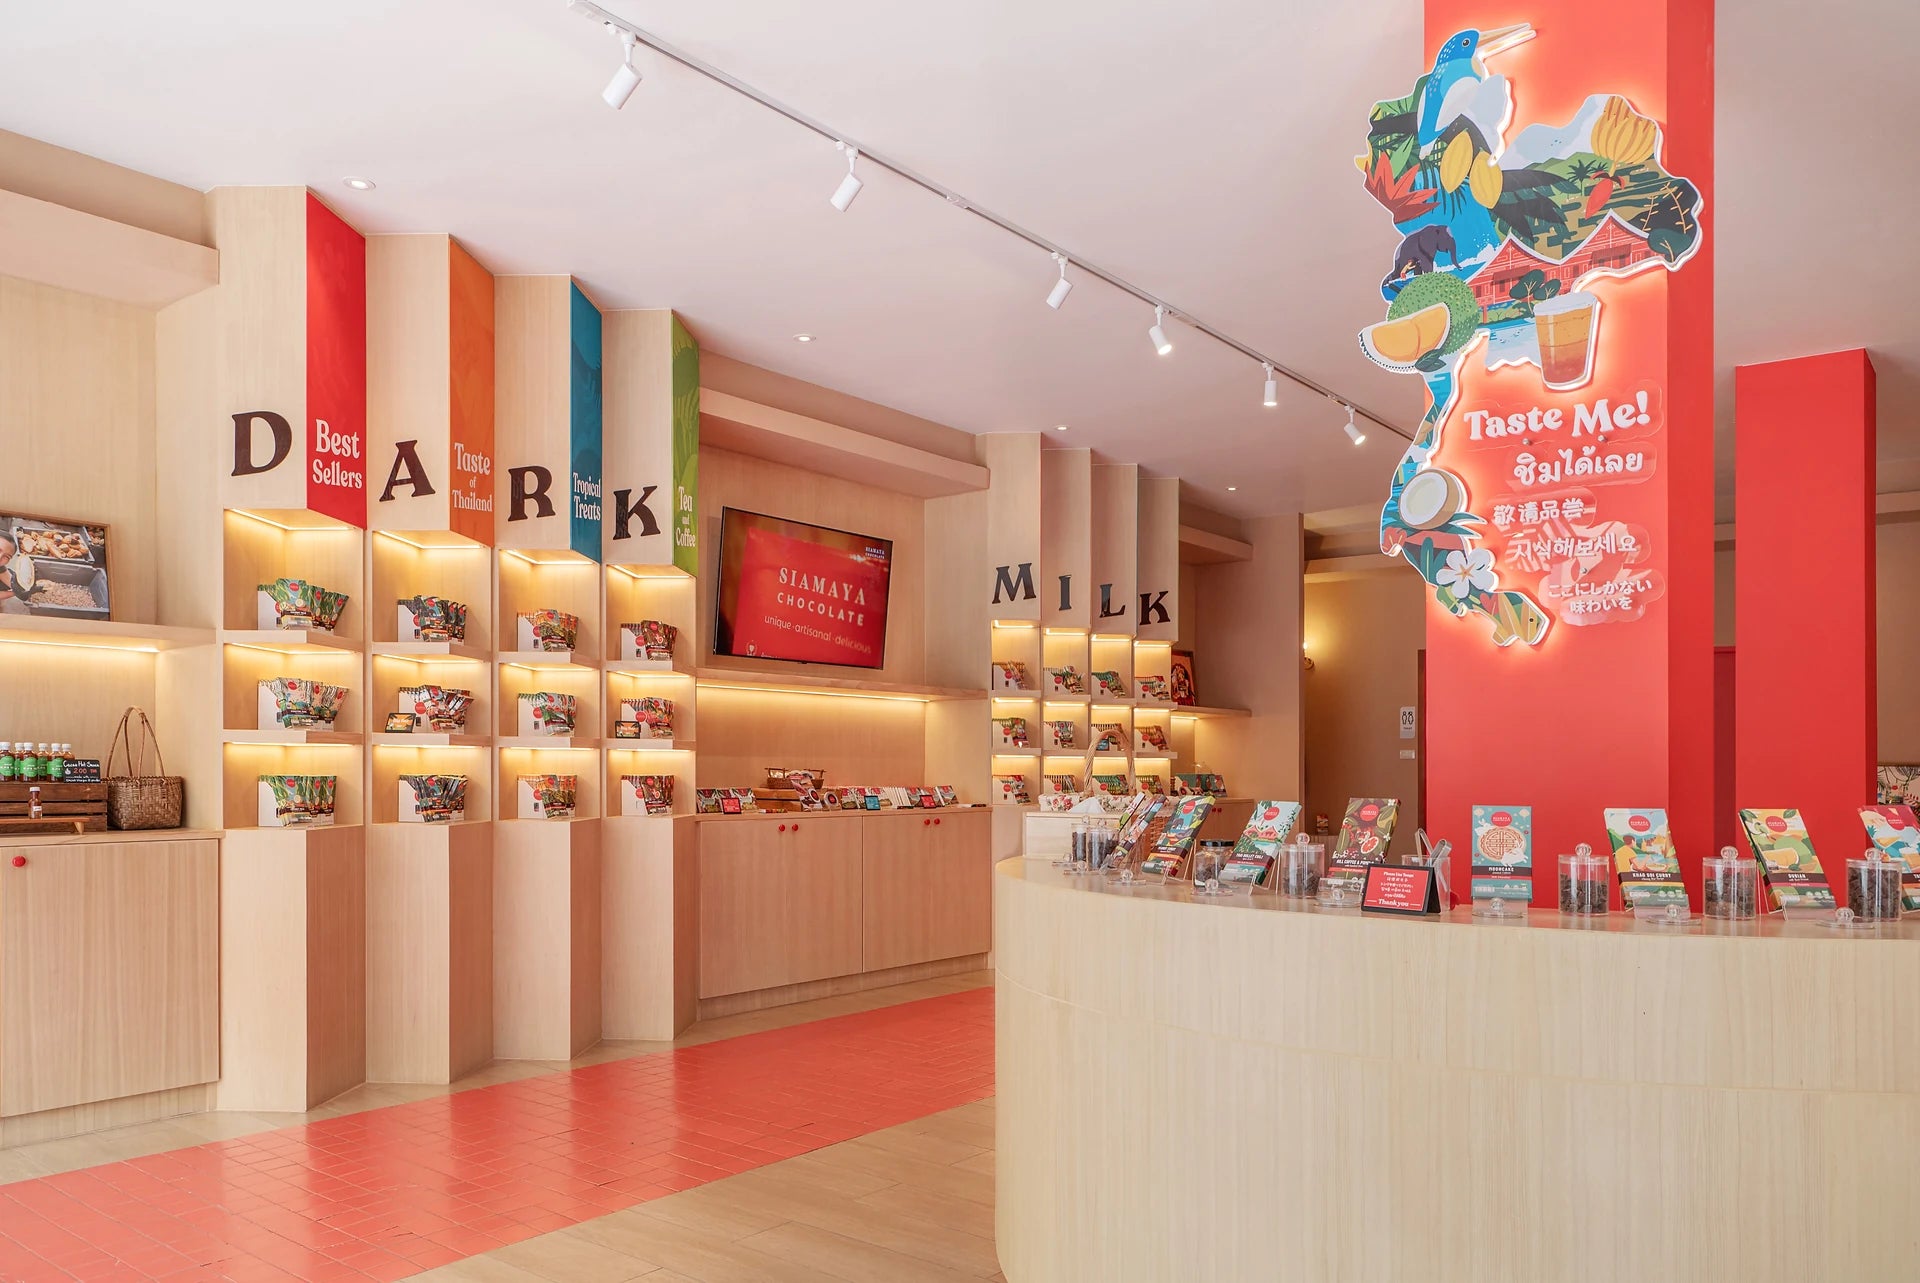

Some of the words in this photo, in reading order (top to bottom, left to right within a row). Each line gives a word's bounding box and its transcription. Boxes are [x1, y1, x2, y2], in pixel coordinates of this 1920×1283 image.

[1463, 406, 1563, 440] Taste
[1571, 390, 1650, 437] Me!
[315, 418, 360, 459] Best
[454, 442, 491, 476] Taste
[1513, 445, 1644, 486] ชิมได้เลย
[312, 458, 363, 489] Sellers
[469, 475, 477, 489] of
[572, 472, 601, 500] Tropical
[452, 489, 493, 512] Thailand
[573, 495, 601, 521] Treats
[678, 486, 693, 512] Tea
[1493, 497, 1585, 525] 敬请品尝
[681, 514, 690, 525] and
[675, 527, 696, 548] Coffee
[779, 567, 866, 606] SIAMAYA
[1548, 579, 1653, 598] ここにしかない
[777, 592, 864, 627] CHOCOLATE
[1569, 596, 1633, 615] 味わいを
[764, 615, 792, 630] unique
[795, 623, 832, 642] artisanal
[835, 634, 872, 655] delicious
[73, 767, 88, 775] 200
[1378, 898, 1398, 906] Thank
[1397, 900, 1409, 908] you
